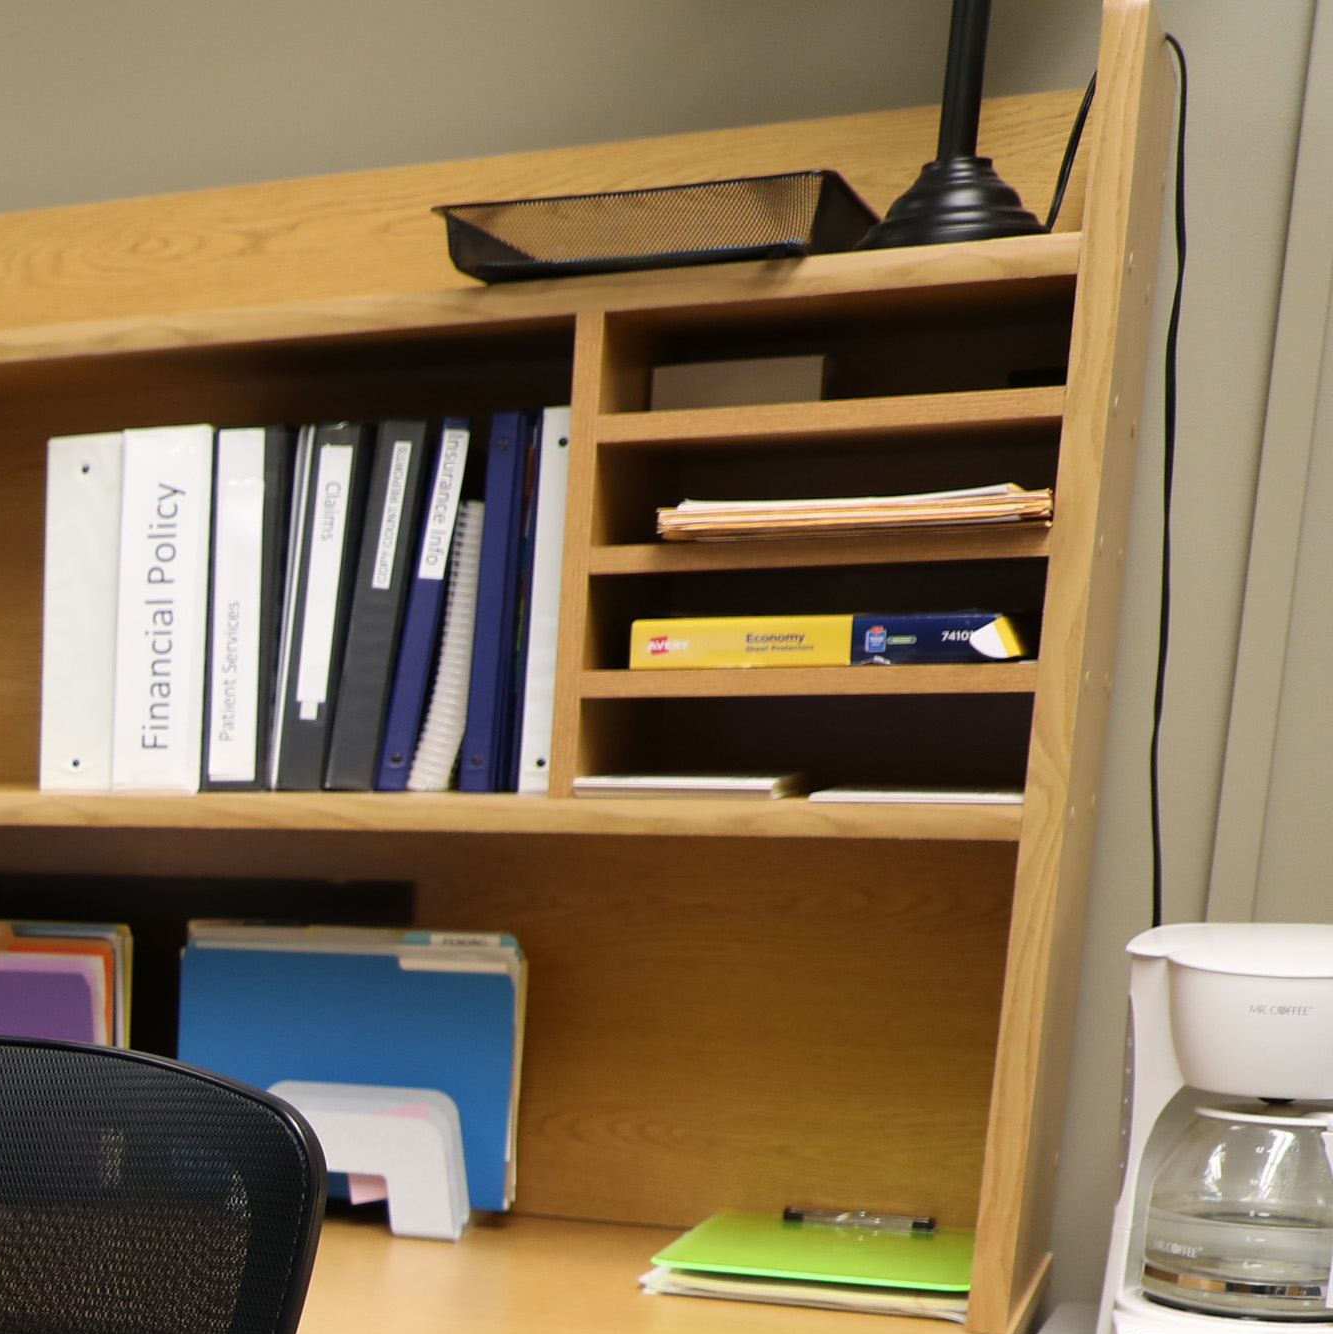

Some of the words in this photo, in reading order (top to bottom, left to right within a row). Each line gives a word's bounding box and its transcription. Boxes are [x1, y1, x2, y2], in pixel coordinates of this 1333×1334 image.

[434, 432, 465, 525] Insurance
[147, 481, 186, 584] Policy
[321, 479, 342, 542] Claims
[426, 528, 448, 566] Info
[221, 601, 240, 674] Services
[647, 640, 690, 650] AVERY
[746, 633, 805, 644] Economy
[141, 598, 174, 750] Financial
[219, 679, 238, 742] Patient
